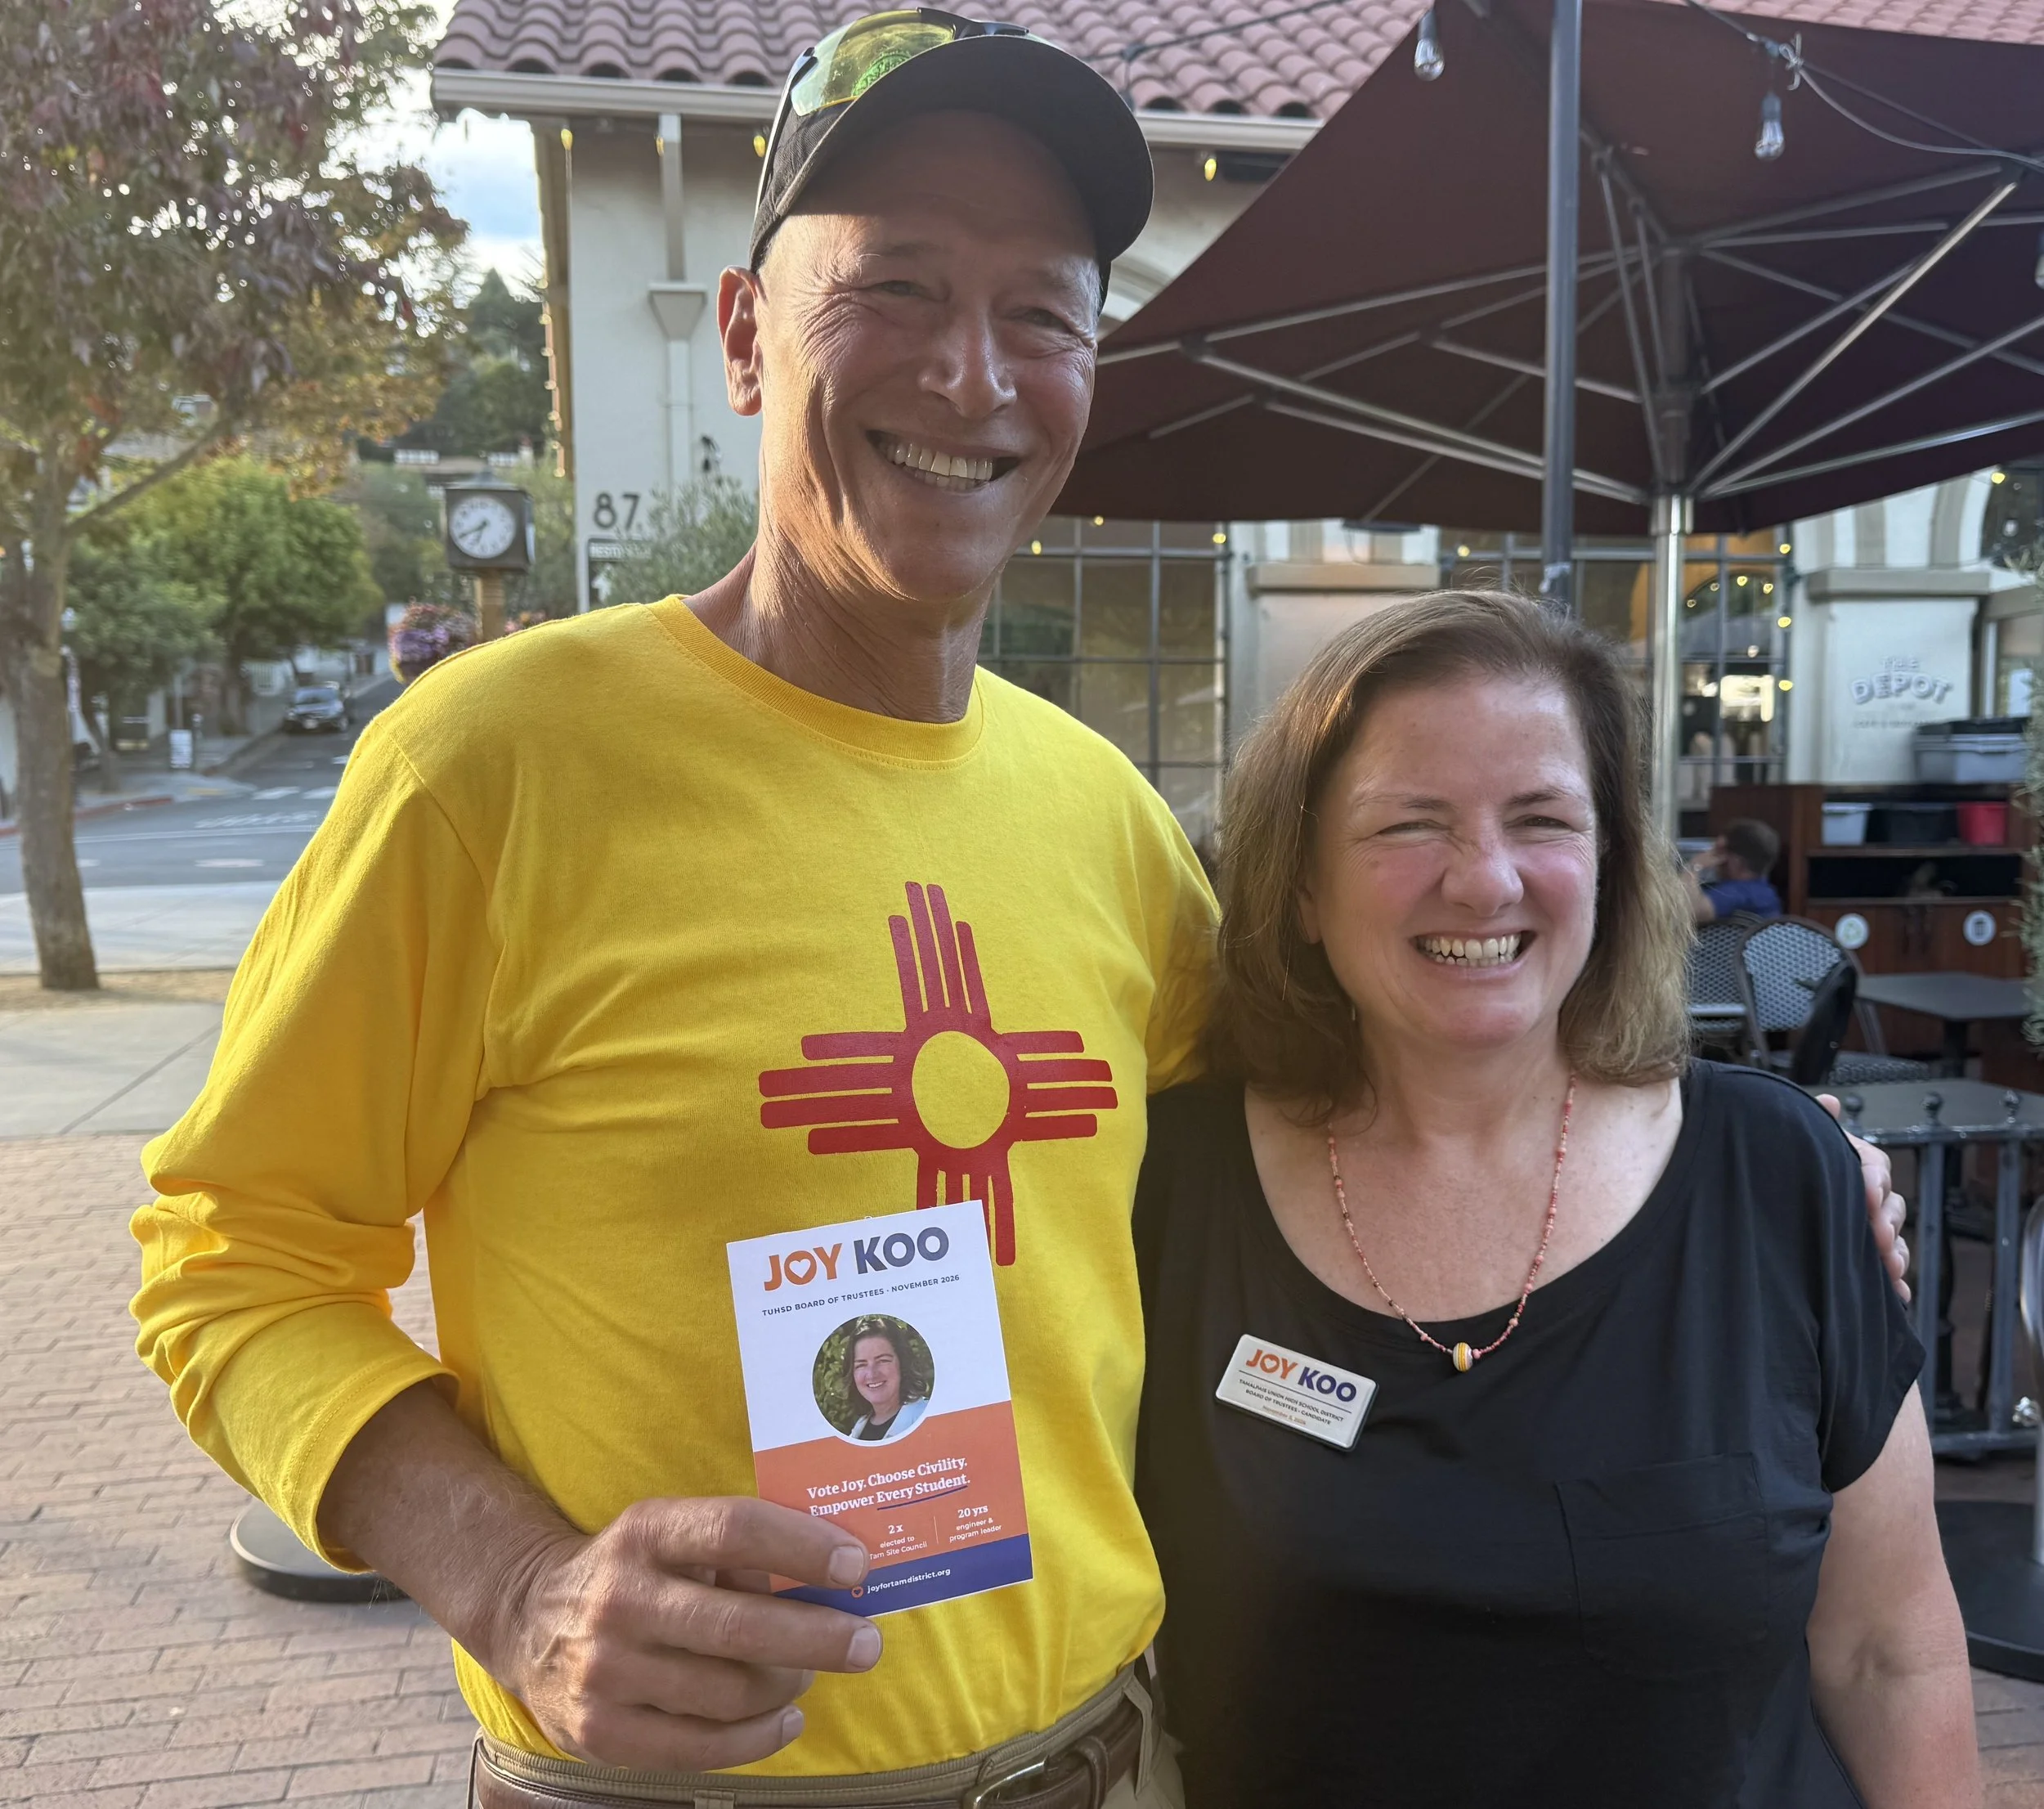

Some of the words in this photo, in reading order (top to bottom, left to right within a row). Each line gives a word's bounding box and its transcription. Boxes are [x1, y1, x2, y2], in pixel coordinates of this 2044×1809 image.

[594, 492, 640, 531] 87
[1850, 672, 1953, 704] DEPOT
[764, 1243, 842, 1291] JOY
[854, 1227, 949, 1274] KOO
[762, 1305, 792, 1316] TUHSD
[795, 1299, 825, 1310] BOARD
[827, 1296, 839, 1304] OF
[842, 1288, 885, 1301] TRUSTEES
[891, 1278, 939, 1292] NOVEMBER
[940, 1274, 960, 1284] 2026
[1245, 1349, 1298, 1380] JOY
[1298, 1366, 1356, 1402] KOO
[1246, 1389, 1264, 1399] BOARD
[1273, 1398, 1298, 1412] TRUSTEES
[1301, 1410, 1331, 1425] CANDIDATE
[1267, 1389, 1284, 1399] UNION
[1285, 1396, 1298, 1404] HIGH
[1298, 1401, 1320, 1413] SCHOOL
[1320, 1410, 1343, 1421] DISTRICT
[807, 1485, 842, 1499] Vote
[841, 1479, 867, 1493] Joy.
[867, 1467, 915, 1487] Choose
[917, 1457, 968, 1475] Civility.
[809, 1494, 874, 1517] Empower
[876, 1487, 913, 1504] Every
[915, 1474, 970, 1495] Student.
[956, 1519, 987, 1531] engineer
[957, 1507, 970, 1519] 20
[971, 1506, 988, 1517] yrs
[880, 1537, 906, 1548] elected
[949, 1530, 979, 1543] program
[980, 1524, 1002, 1534] leader
[869, 1552, 885, 1560] Tam
[886, 1547, 899, 1556] Site
[901, 1541, 927, 1553] Council
[867, 1568, 951, 1594] joyfortamdistrict.org
